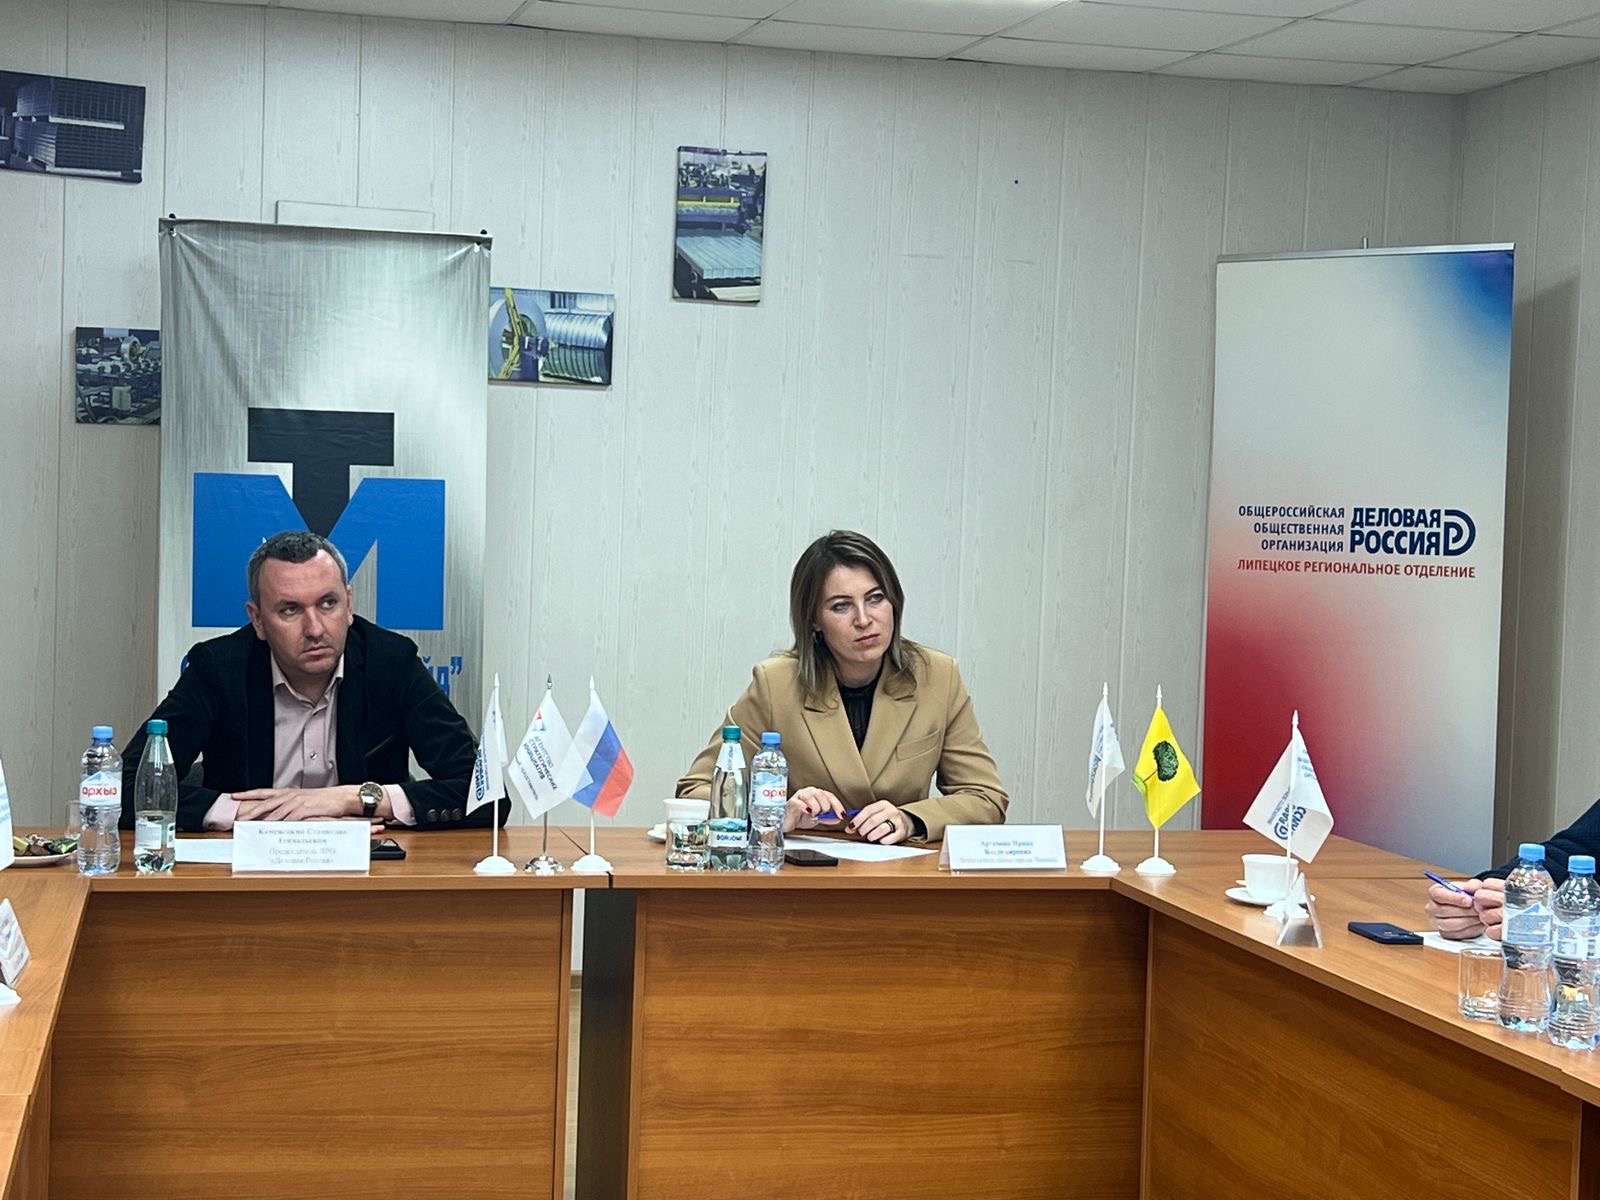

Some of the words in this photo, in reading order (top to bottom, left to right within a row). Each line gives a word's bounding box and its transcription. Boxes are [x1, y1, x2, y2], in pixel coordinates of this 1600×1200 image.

[1238, 505, 1345, 519] ОБЩЕРОССИЙСКАЯ
[1350, 507, 1441, 529] ДЕЛОВАЯ
[1253, 522, 1344, 536] ОБЩЕСТВЕННАЯ
[1261, 539, 1344, 554] ОРГАНИЗАЦИЯ
[1349, 529, 1441, 556] РОССИЯ
[1237, 559, 1301, 574] ЛИПЕЦКОЕ
[1303, 562, 1401, 576] РЕГИОНАЛЬНОЕ
[1403, 564, 1476, 579] ОТДЕЛЕНИЕ
[523, 743, 546, 780] ИНИЦИАТИВ
[528, 738, 558, 790] СТРАТЕГИЧЕСКИХ
[82, 787, 117, 797] архыз
